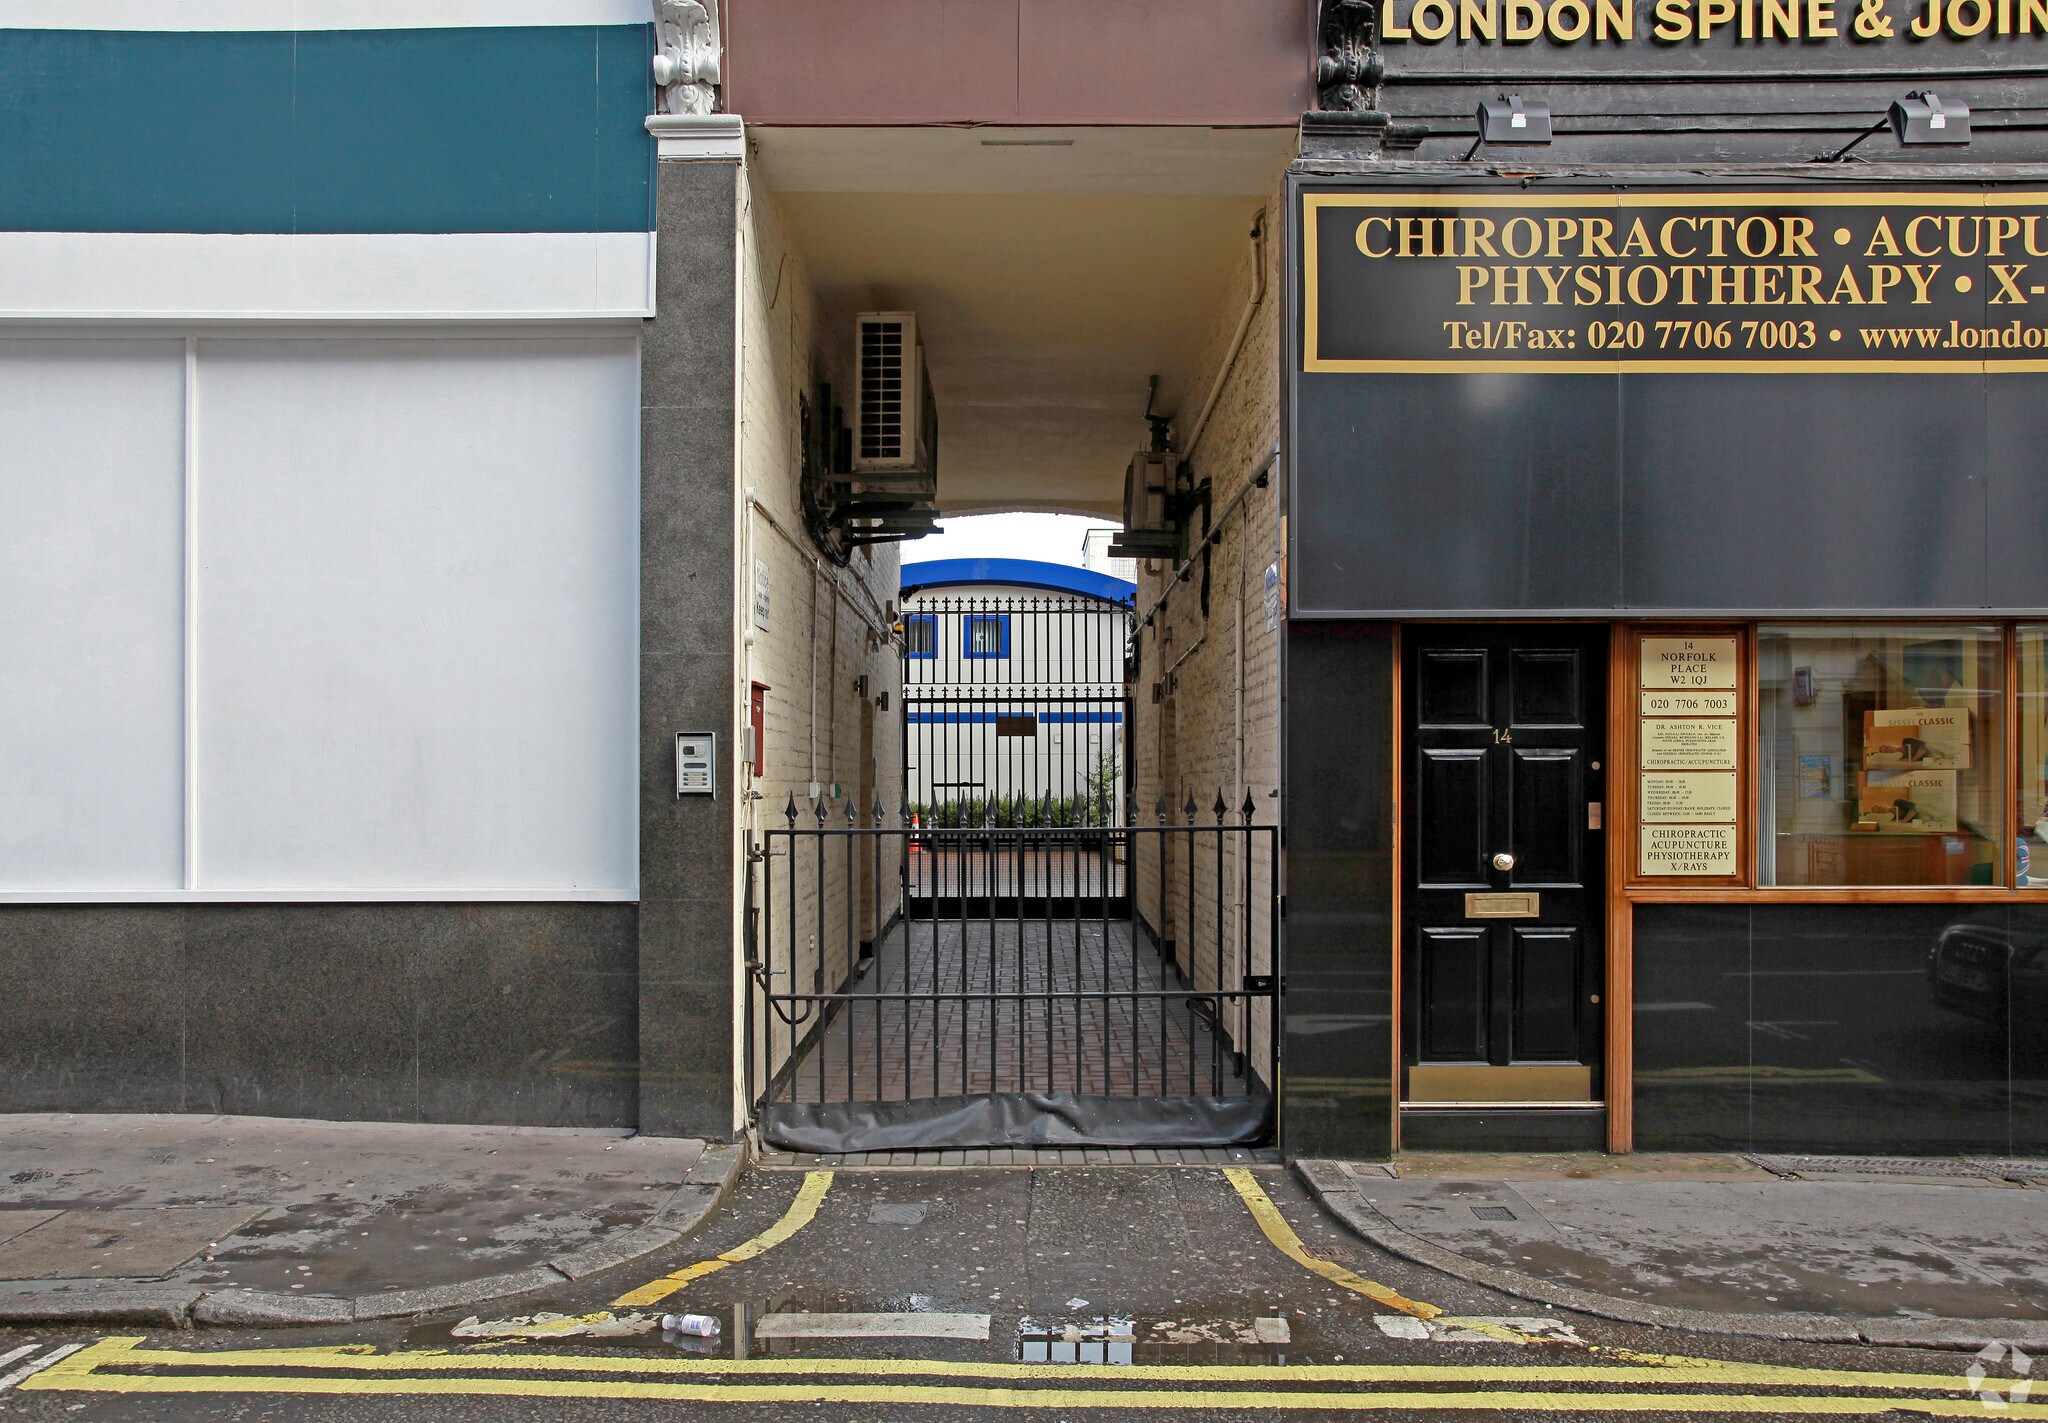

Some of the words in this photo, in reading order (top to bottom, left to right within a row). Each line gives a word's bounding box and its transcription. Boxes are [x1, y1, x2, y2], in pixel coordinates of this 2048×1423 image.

[1382, 0, 1633, 41] LONDON
[1653, 0, 1838, 41] SPINE
[1854, 0, 1895, 39] &
[1355, 216, 1819, 258] CHIROPRACTOR
[1456, 264, 1942, 306] PHYSIOTHERAPY
[1443, 320, 1576, 350] Tel/Fax:
[1587, 320, 1645, 350] 020
[1654, 320, 1732, 349] 7706
[1740, 320, 1816, 349] 7003
[1859, 320, 2048, 349] www.londo
[1684, 641, 1694, 650] 14
[1661, 652, 1717, 662] NORFOLK
[1671, 664, 1707, 673] PLACE
[1670, 675, 1686, 685] W2
[1691, 675, 1708, 686] 1QJ
[1650, 699, 1669, 709] 020
[1675, 699, 1698, 709] 7706
[1704, 699, 1728, 709] 7003
[1918, 717, 1955, 726] CLASSIC
[1493, 728, 1513, 744] 14
[1908, 779, 1943, 787] CLASSIC
[1651, 829, 1727, 838] CHIROPRACTIC
[1651, 840, 1727, 849] ACUPUNCTURE
[1647, 851, 1730, 860] PHYSIOTHERAPY
[1670, 862, 1708, 871] X/RAYS
